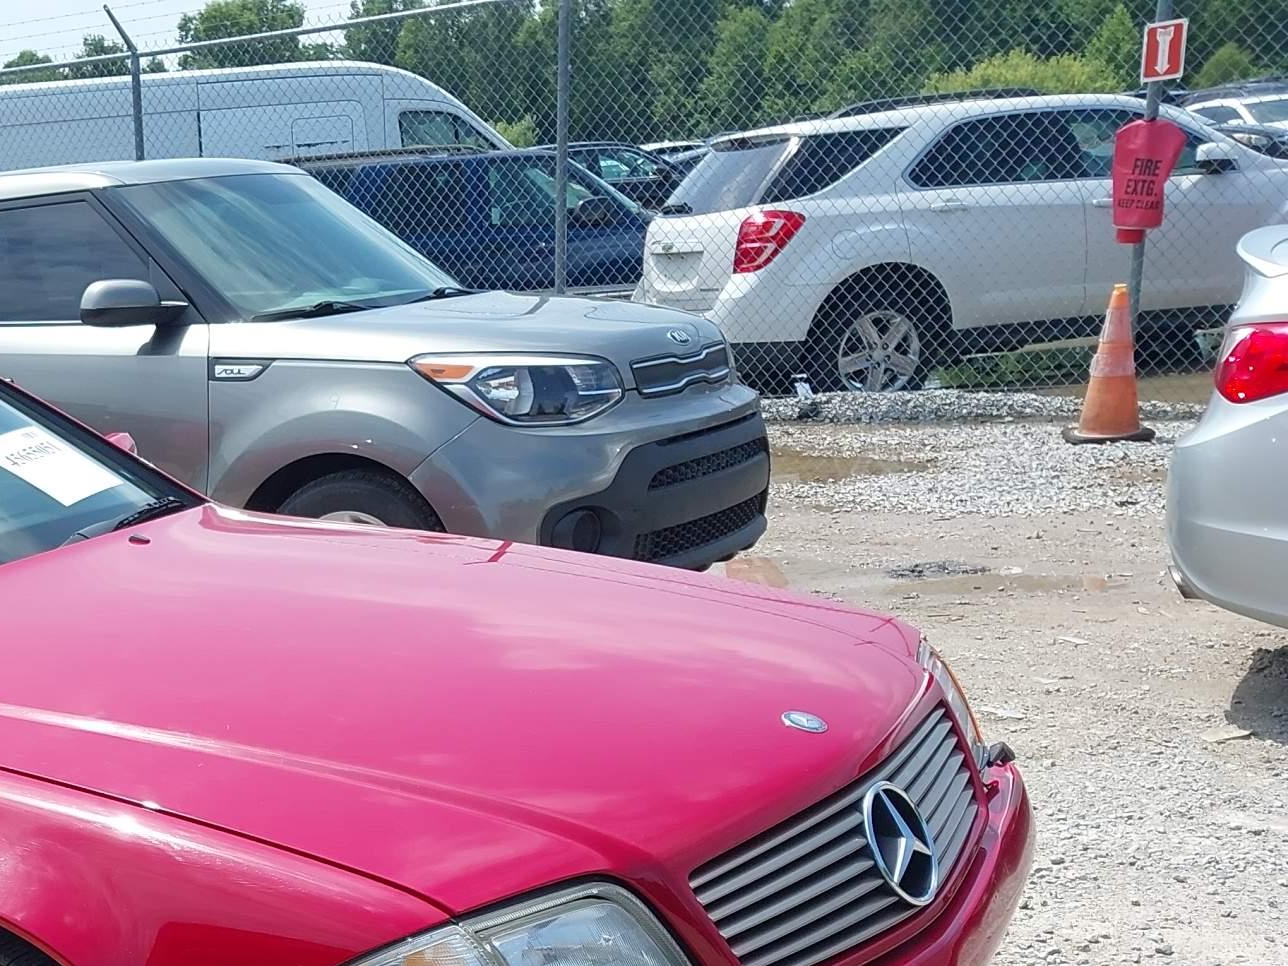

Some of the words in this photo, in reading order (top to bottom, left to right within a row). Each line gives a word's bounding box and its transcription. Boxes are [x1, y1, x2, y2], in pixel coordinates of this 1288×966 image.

[1132, 158, 1163, 176] FIRE
[1124, 179, 1157, 197] EXTG.
[1117, 199, 1134, 209] KEEP
[1135, 199, 1161, 210] CLEAR
[5, 440, 62, 467] 45655051
